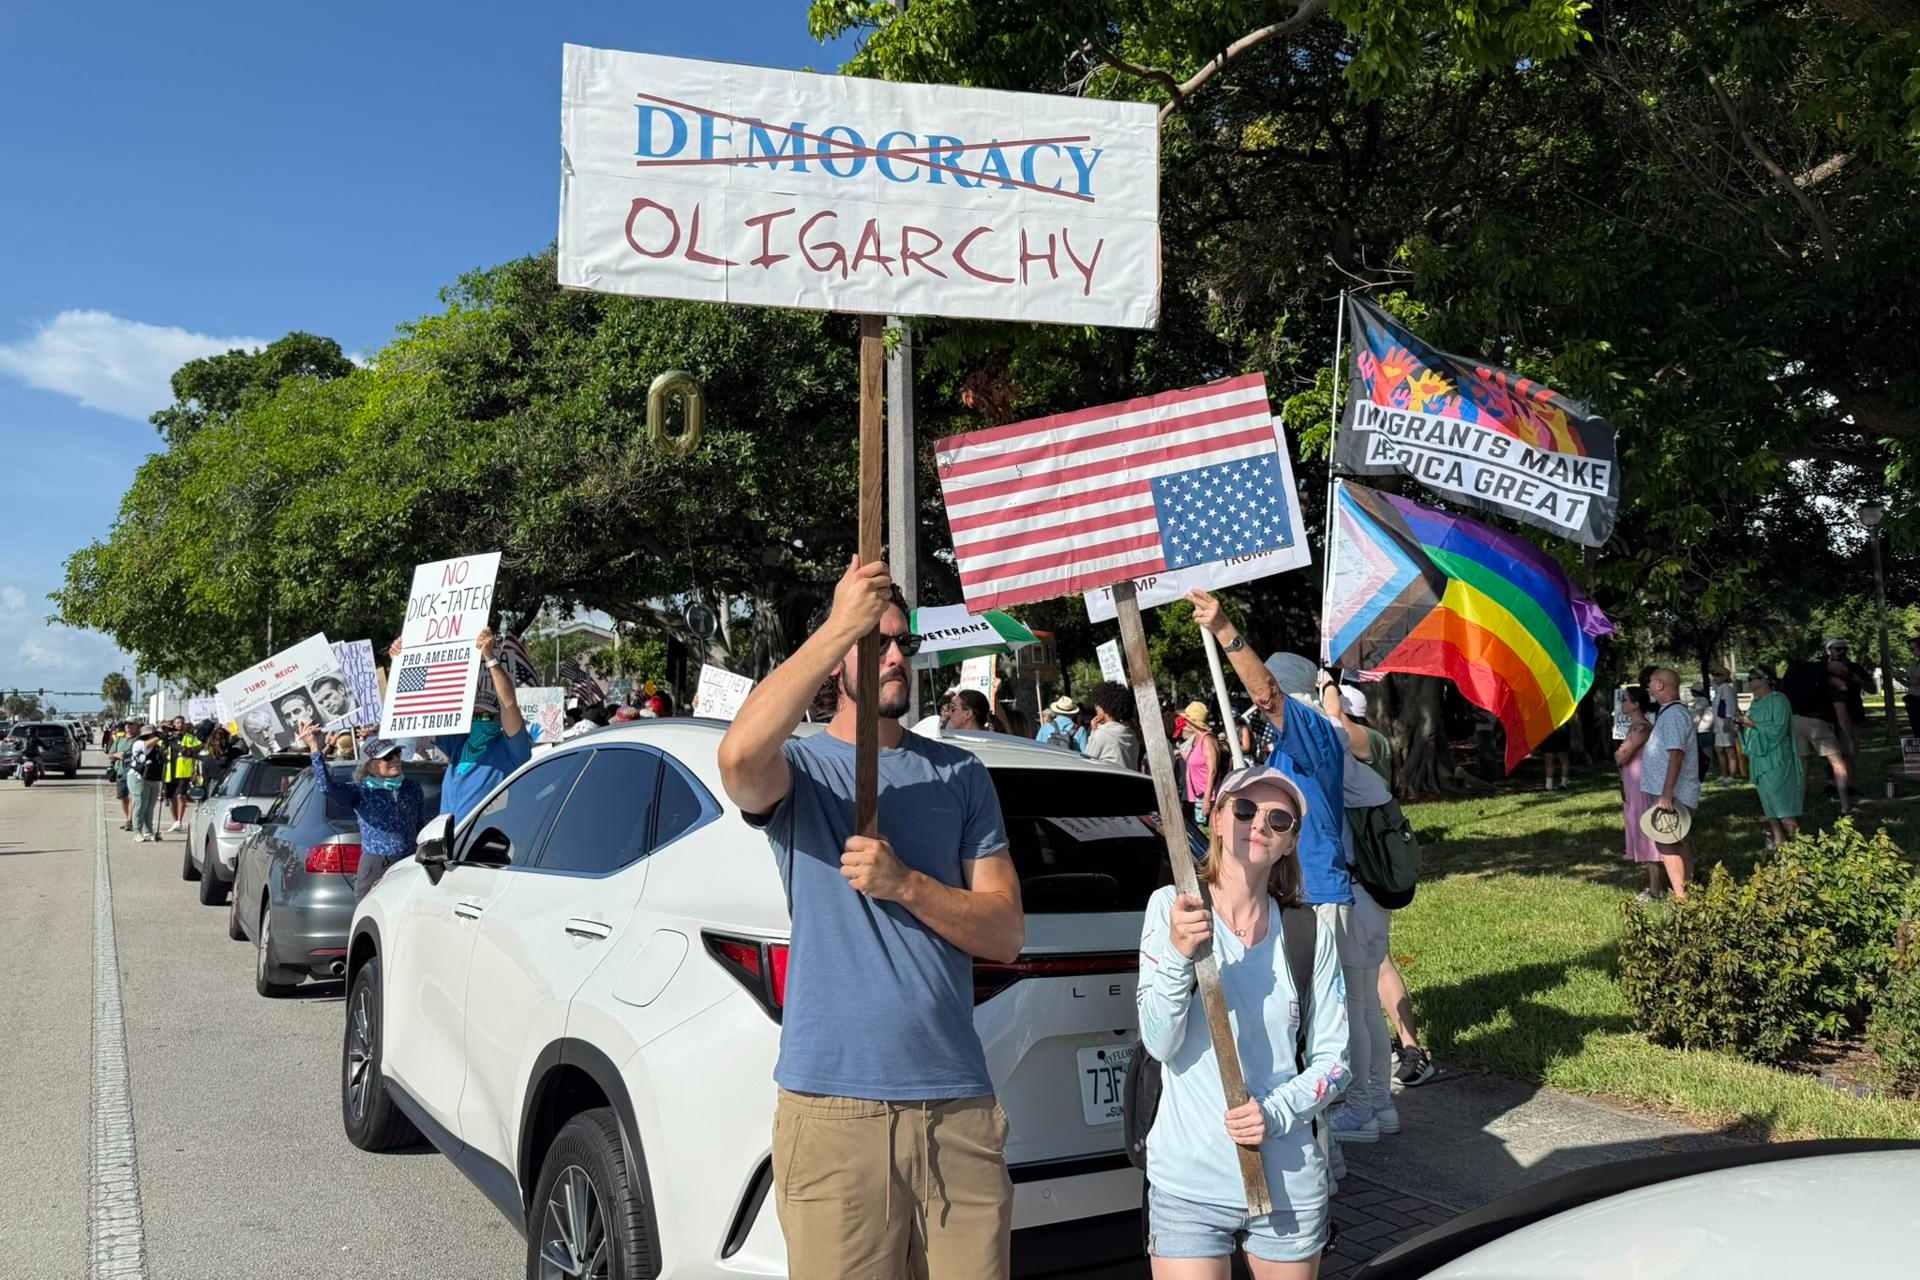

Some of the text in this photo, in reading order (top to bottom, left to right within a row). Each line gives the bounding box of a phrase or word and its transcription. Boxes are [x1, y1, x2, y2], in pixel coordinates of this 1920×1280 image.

[634, 102, 1103, 198] DEMOCRACY
[625, 198, 1104, 296] OLIGARCHY
[1518, 448, 1607, 491] MAKE
[1474, 470, 1585, 524] GREAT
[1224, 550, 1273, 567] TRU
[441, 560, 470, 588] NO
[1101, 576, 1157, 601] TMP
[407, 584, 493, 622] DICK-TATER
[425, 614, 463, 642] DON
[920, 621, 990, 642] VETERANS
[257, 660, 275, 673] THE
[402, 647, 471, 667] PRO-AMERICA
[390, 712, 462, 732] ANTI-TRUMP
